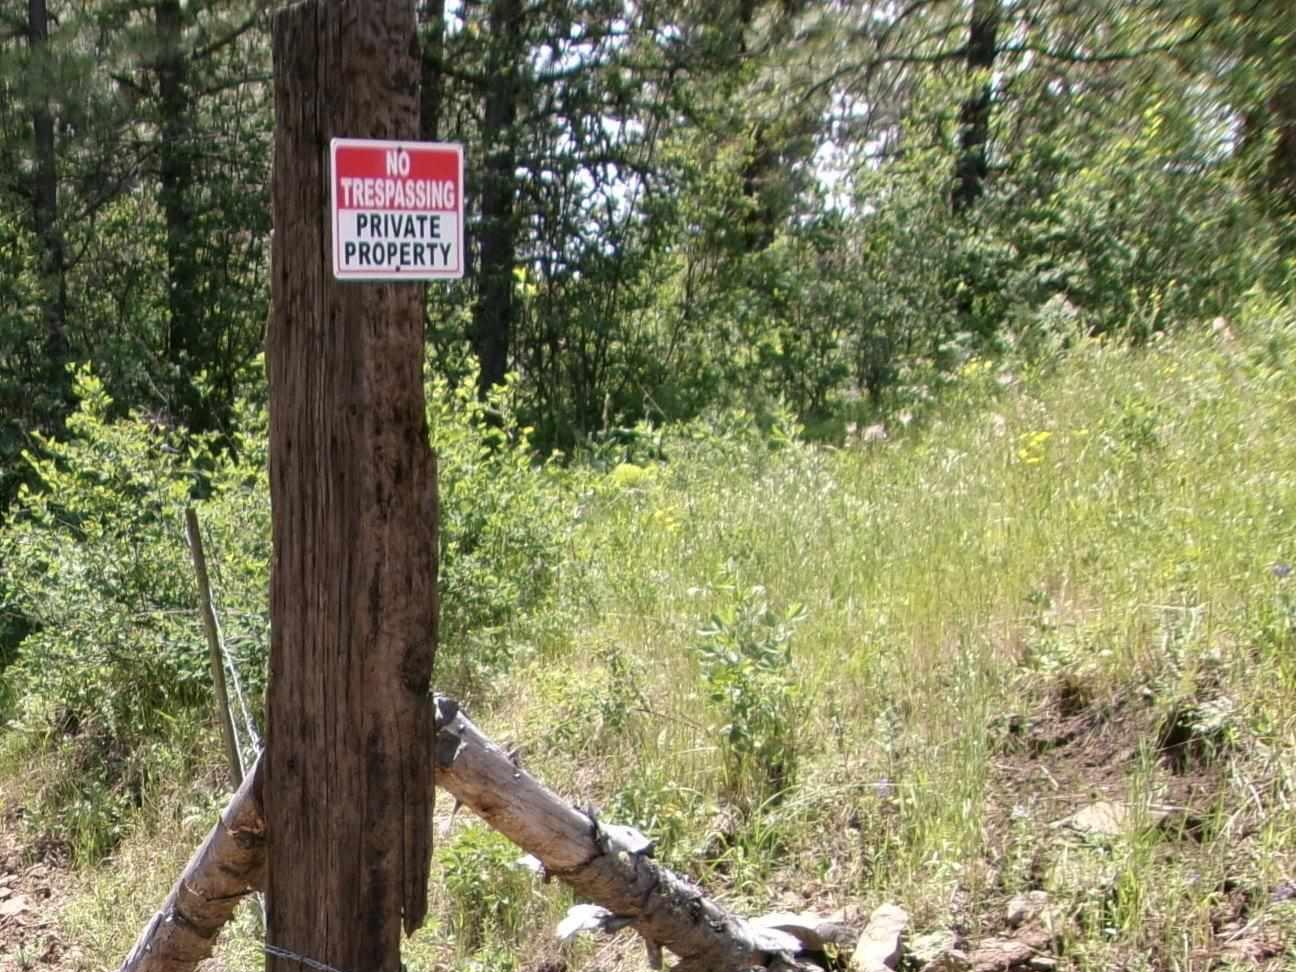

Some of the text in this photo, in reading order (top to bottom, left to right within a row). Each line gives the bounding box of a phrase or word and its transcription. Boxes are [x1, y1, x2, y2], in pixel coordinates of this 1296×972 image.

[386, 149, 410, 176] NO
[340, 177, 454, 208] TRESPASSING
[357, 213, 440, 238] PRIVATE
[345, 242, 451, 266] PROPERTY
